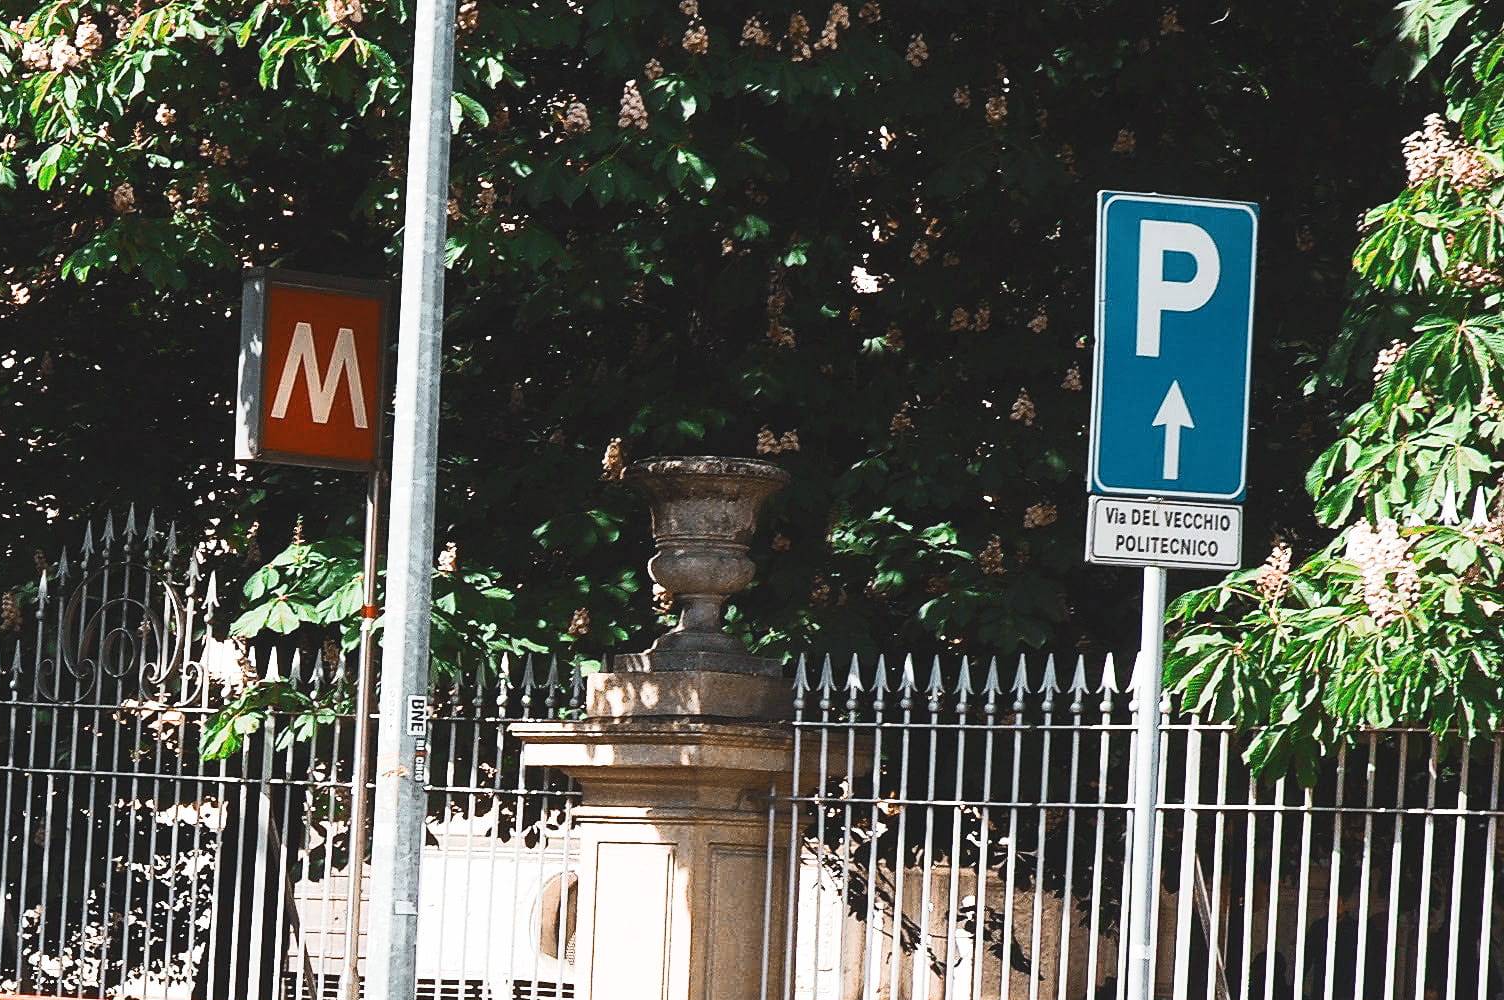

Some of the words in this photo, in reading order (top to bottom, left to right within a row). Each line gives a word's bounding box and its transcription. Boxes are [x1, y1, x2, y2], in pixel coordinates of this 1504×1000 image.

[1135, 219, 1221, 358] P
[270, 321, 369, 429] M
[1105, 506, 1127, 525] Via
[1131, 508, 1160, 527] DEL
[1164, 510, 1231, 532] VECCHIO
[1115, 534, 1219, 557] POLITECNICO
[410, 699, 425, 732] BNE
